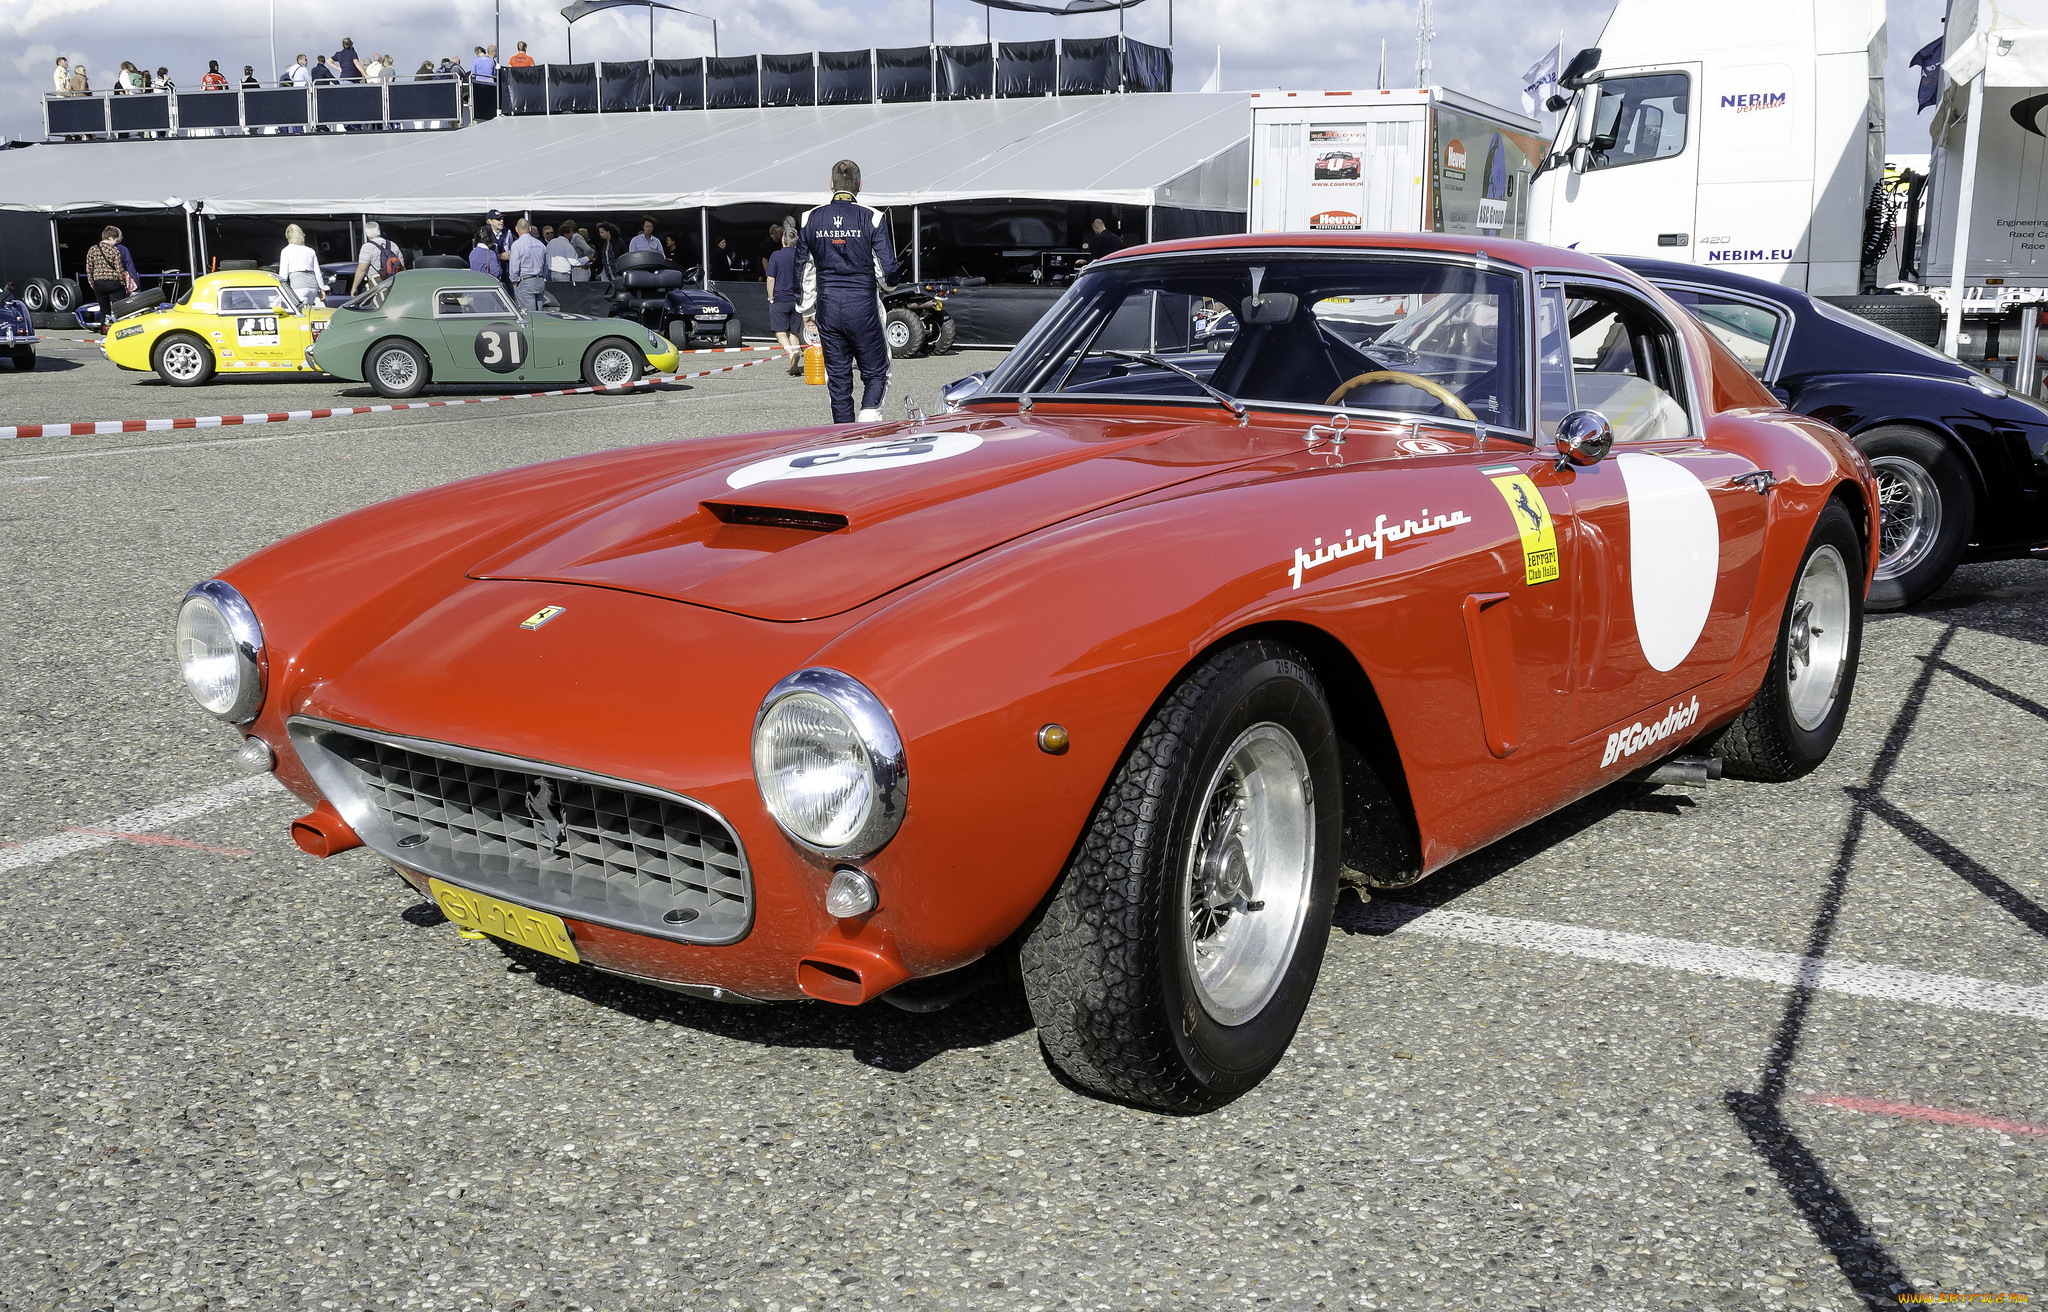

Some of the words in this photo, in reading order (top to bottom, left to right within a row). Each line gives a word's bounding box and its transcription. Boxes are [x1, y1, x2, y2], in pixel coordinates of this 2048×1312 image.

[1720, 92, 1786, 108] NEBIM
[1320, 214, 1361, 224] Heuvel
[1997, 219, 2048, 228] Engineering
[816, 229, 861, 238] MASERATI
[1700, 236, 1731, 244] 420
[1709, 250, 1793, 261] NEBIM.EU
[702, 306, 720, 314] DHG
[258, 317, 275, 331] 16
[481, 331, 521, 364] 31
[1288, 508, 1472, 591] pininfarina
[1527, 547, 1556, 568] Ferrari
[1528, 568, 1541, 581] Club
[1542, 564, 1557, 578] Italia
[1600, 694, 1700, 769] BFGoodrich
[440, 887, 569, 955] GV-21-TL
